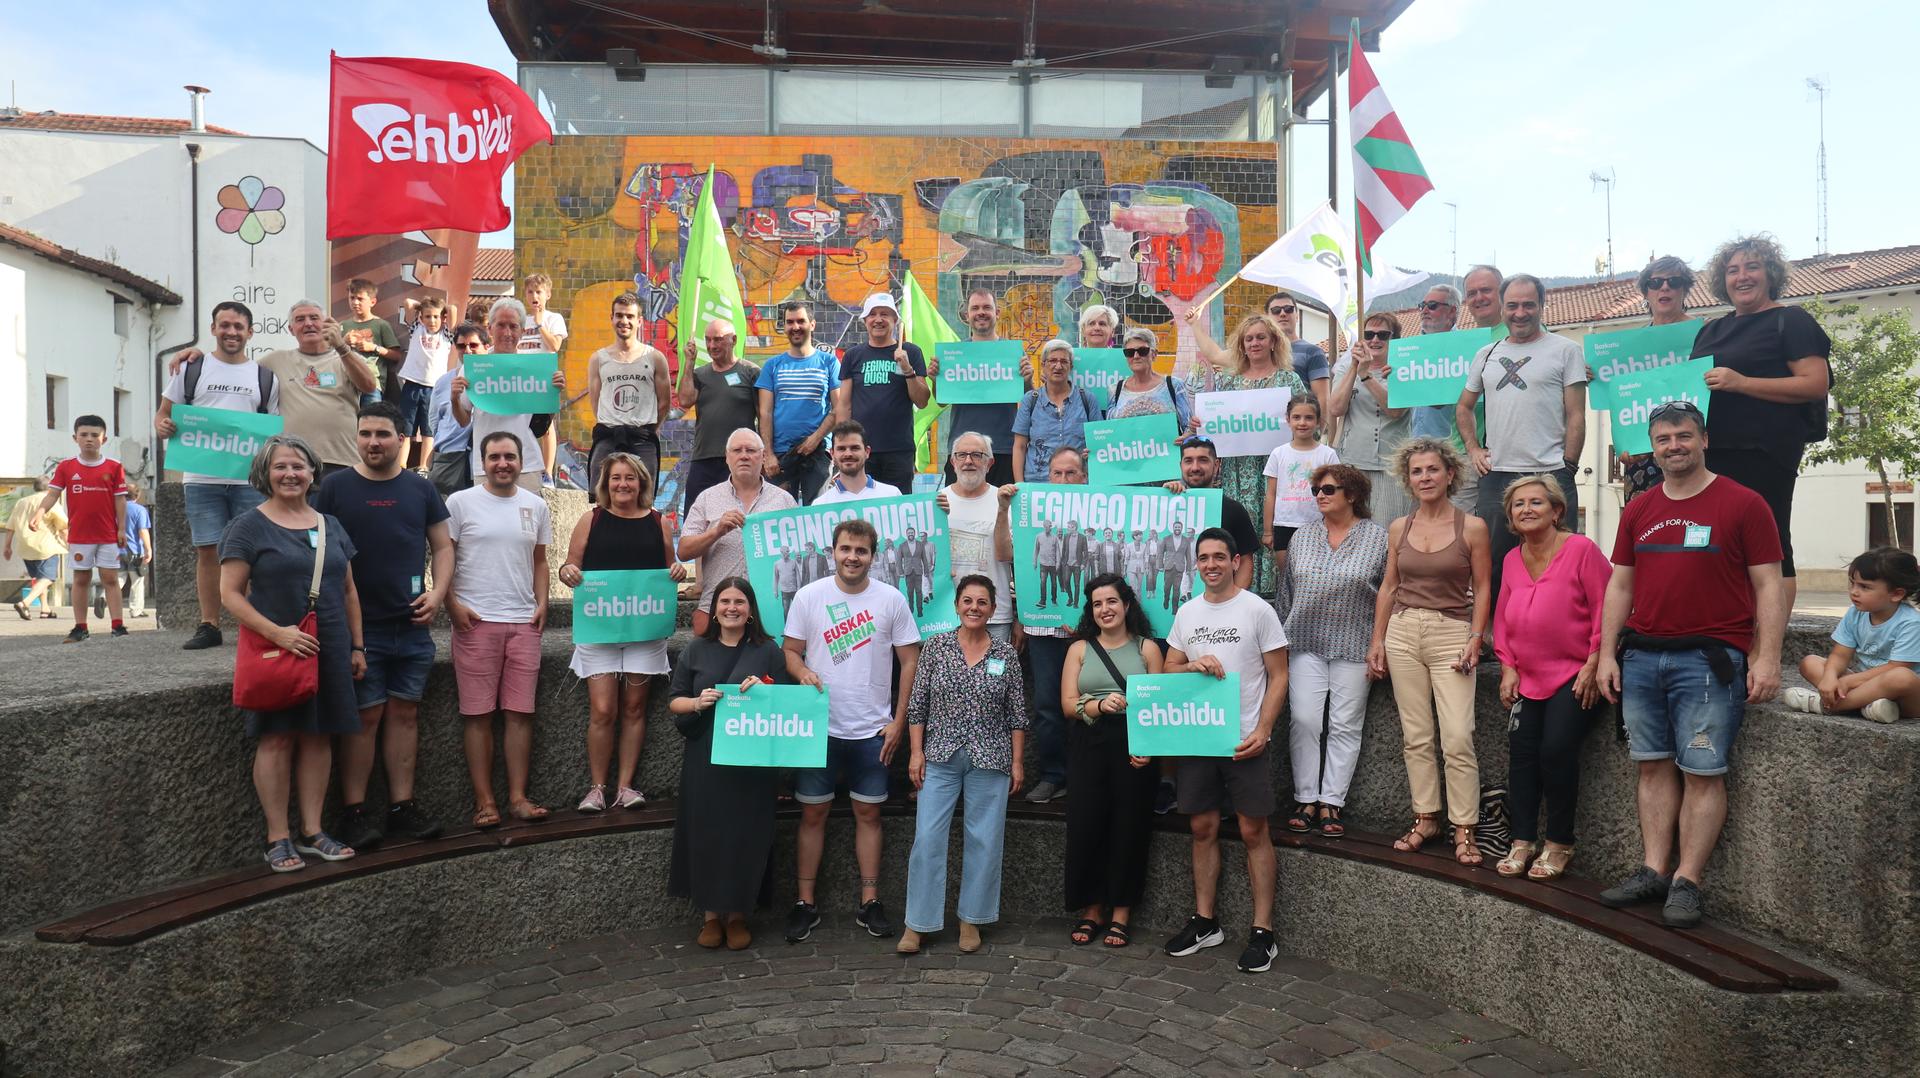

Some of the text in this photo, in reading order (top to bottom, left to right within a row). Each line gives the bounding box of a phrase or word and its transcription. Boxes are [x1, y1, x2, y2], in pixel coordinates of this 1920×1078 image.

[382, 104, 512, 163] ehbildu
[233, 282, 275, 304] aire
[607, 374, 647, 382] BERGARA
[944, 363, 1013, 382] ehbildu
[1067, 370, 1124, 388] hbild
[474, 376, 547, 394] ehbildu
[1205, 412, 1280, 434] ehbildu
[1096, 439, 1170, 463] ehbildu
[1018, 493, 1028, 528] Berriro
[1031, 491, 1126, 532] EGINGO
[752, 523, 764, 558] Berriro
[1640, 522, 1665, 541] THANKS
[1666, 518, 1681, 526] FOR
[583, 594, 665, 617] ehbildu
[1023, 612, 1062, 621] Seguiremos
[823, 609, 873, 644] EUSKAL
[920, 621, 952, 633] ehbildu
[828, 621, 877, 657] HERRIA
[725, 712, 814, 737] ehbildu
[1137, 701, 1226, 726] ehbildu
